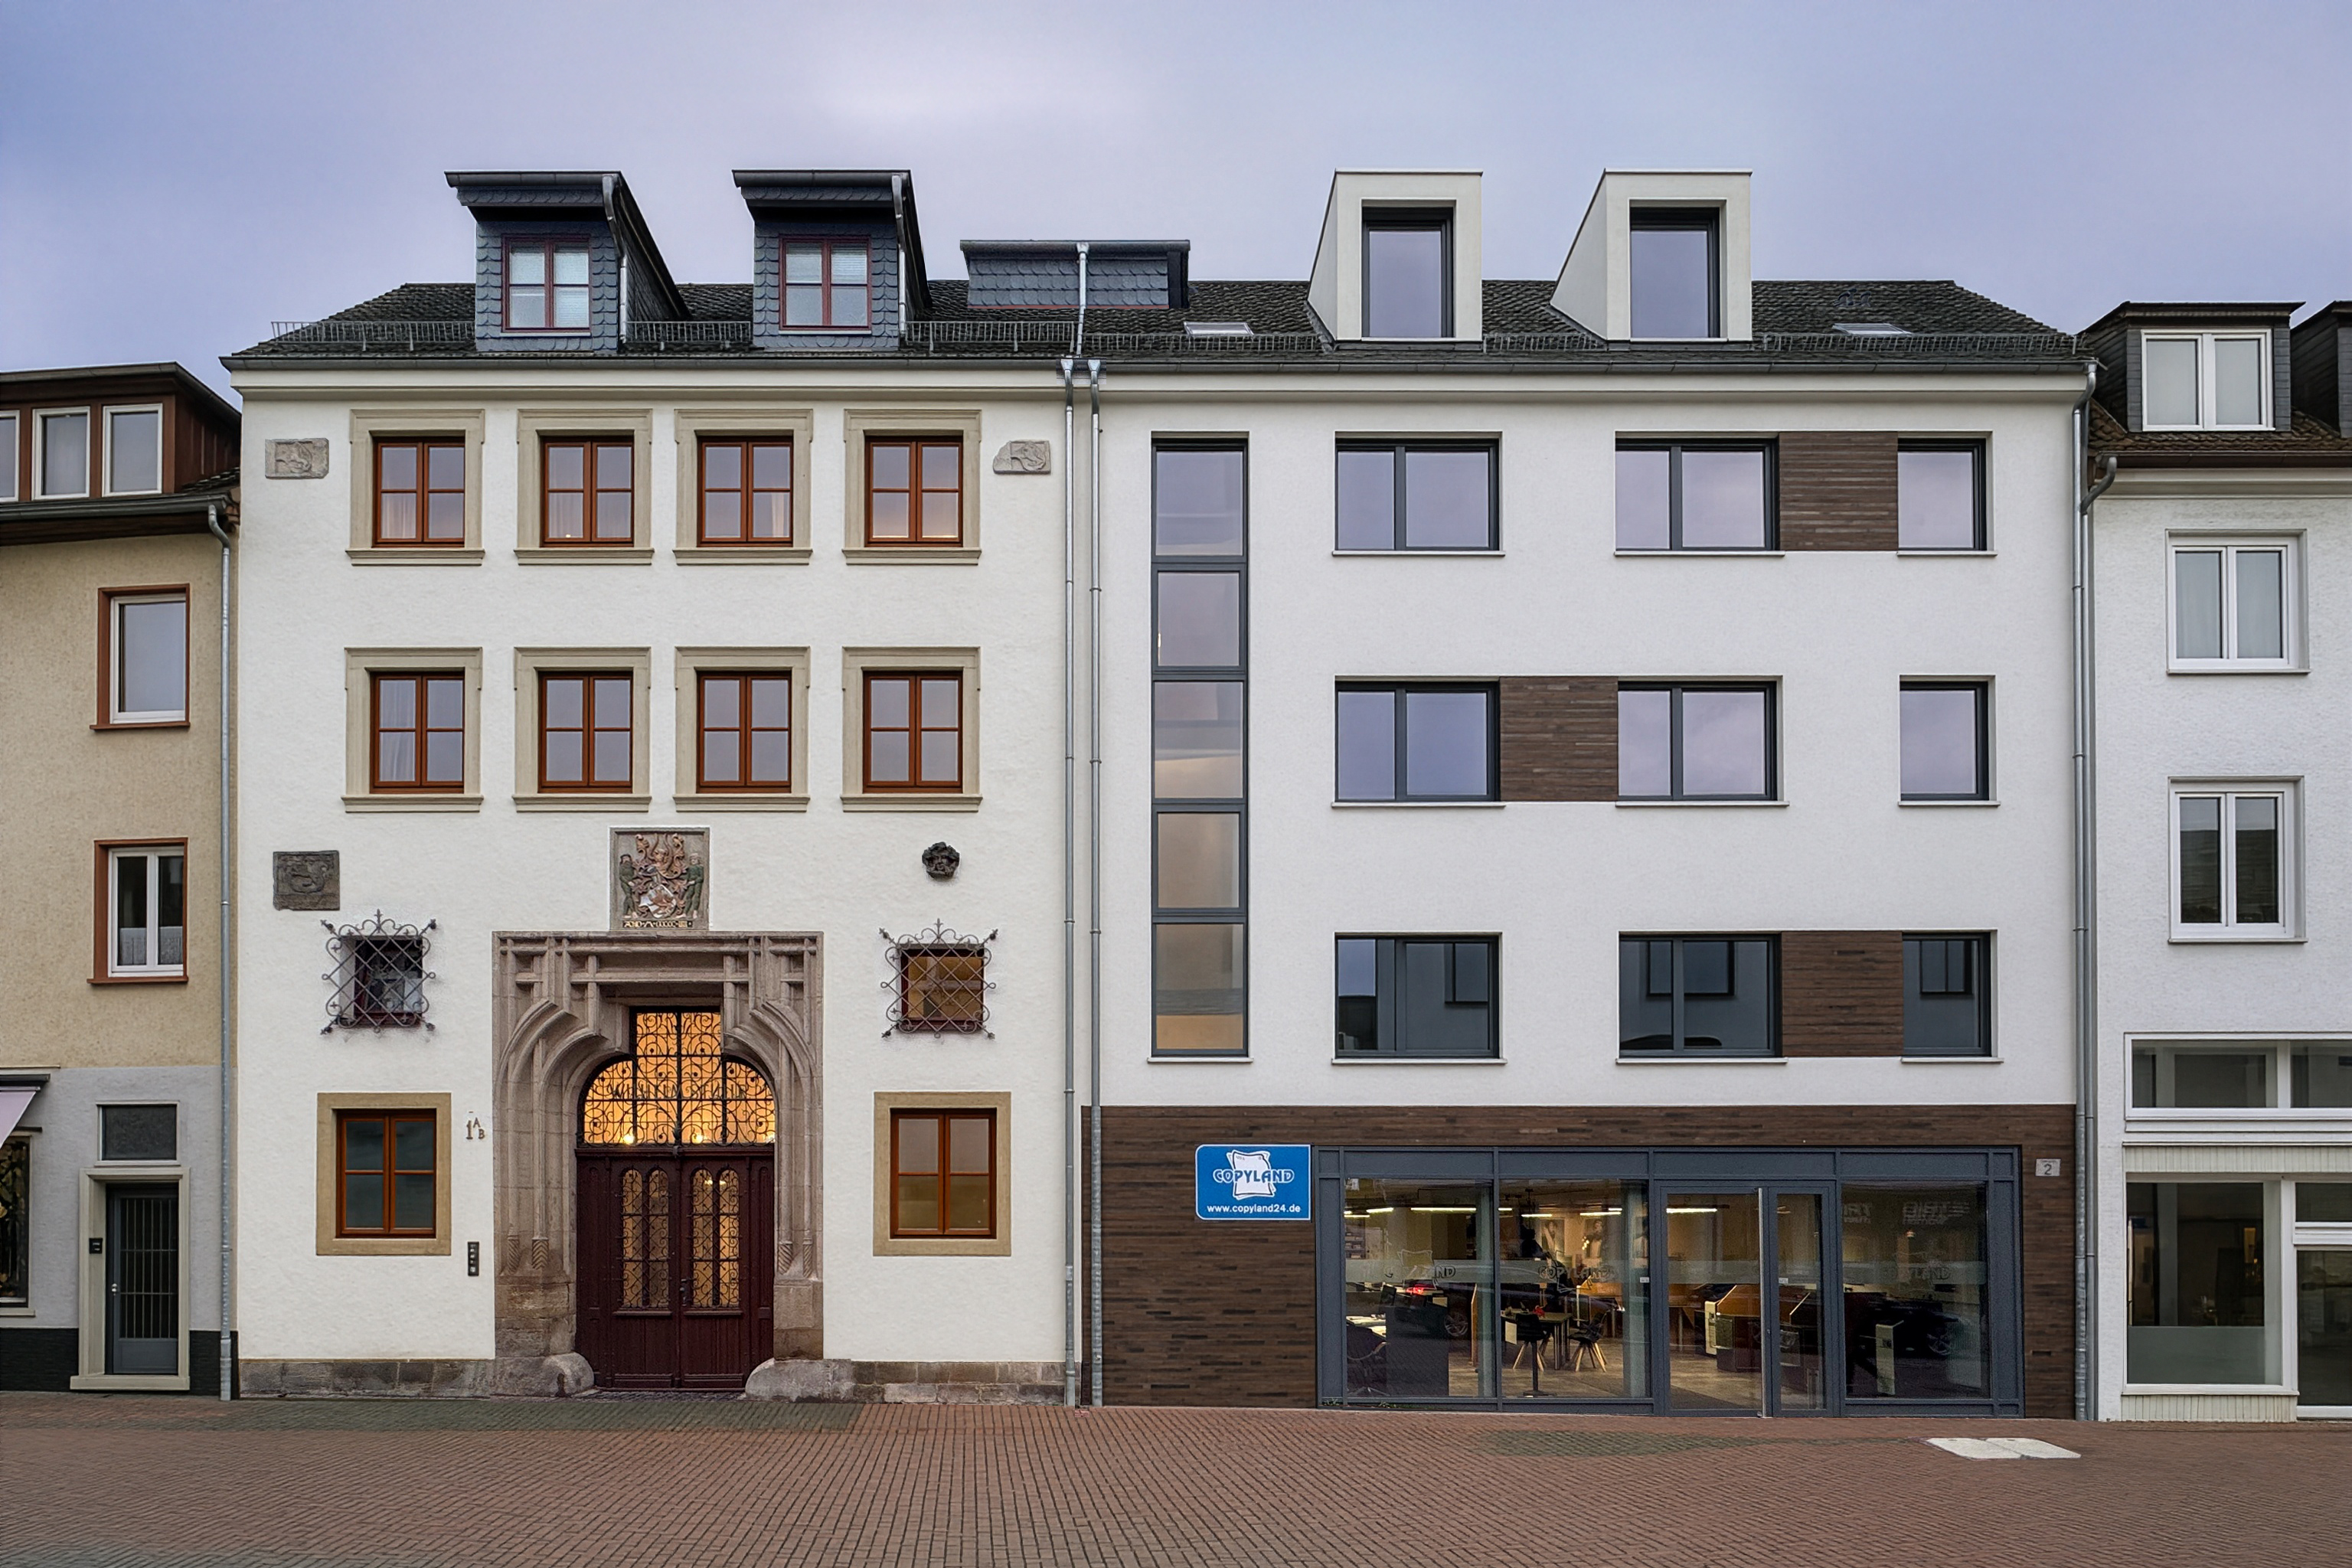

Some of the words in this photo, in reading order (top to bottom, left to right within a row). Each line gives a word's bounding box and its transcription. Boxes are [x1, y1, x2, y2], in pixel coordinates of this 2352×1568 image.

[2043, 1163, 2052, 1175] 2
[1213, 1169, 1295, 1184] COPYLAND
[1207, 1204, 1302, 1214] www.copyland24.de
